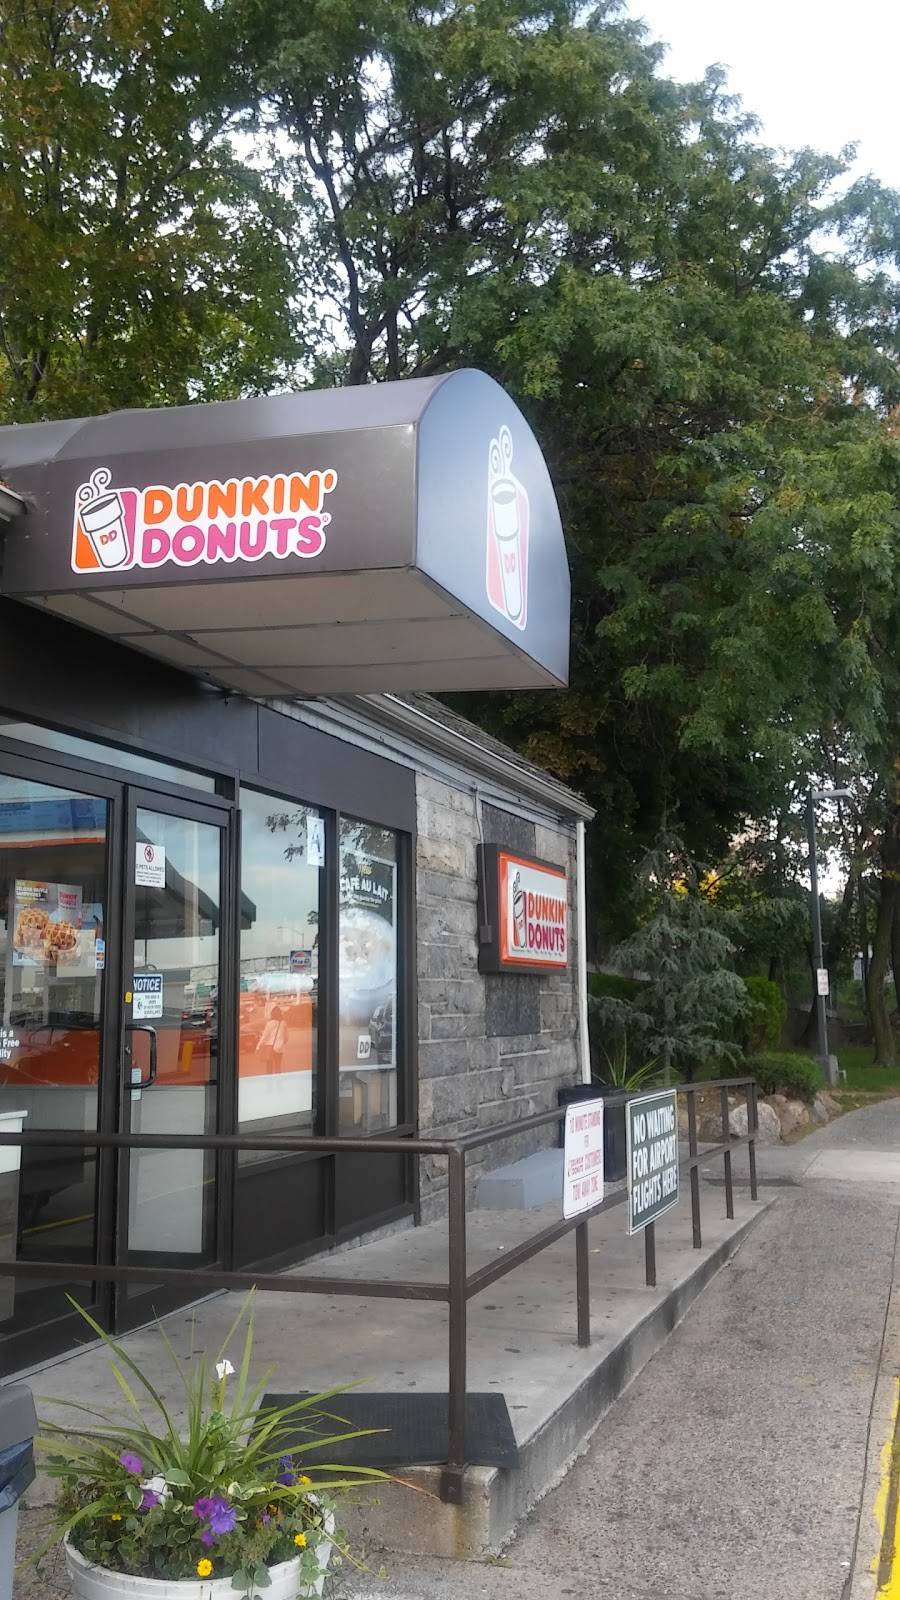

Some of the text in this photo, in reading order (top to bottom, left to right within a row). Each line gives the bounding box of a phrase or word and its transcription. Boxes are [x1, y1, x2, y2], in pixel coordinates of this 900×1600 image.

[143, 472, 334, 525] DUNKIN'
[99, 529, 117, 546] DD
[141, 515, 322, 563] DONUTS
[503, 553, 516, 574] DD
[339, 874, 361, 894] CAFÉ
[361, 878, 372, 892] AU
[372, 881, 389, 901] LAIT
[527, 892, 567, 924] DUNKIN'
[528, 922, 565, 953] DONUTS
[133, 978, 160, 991] NOTICE
[3, 1039, 20, 1048] Free
[359, 1040, 370, 1055] DD
[633, 1104, 675, 1145] NO WAITING
[633, 1134, 676, 1180] FOR AIRPORT
[633, 1165, 678, 1216] FLIGHTS HERE
